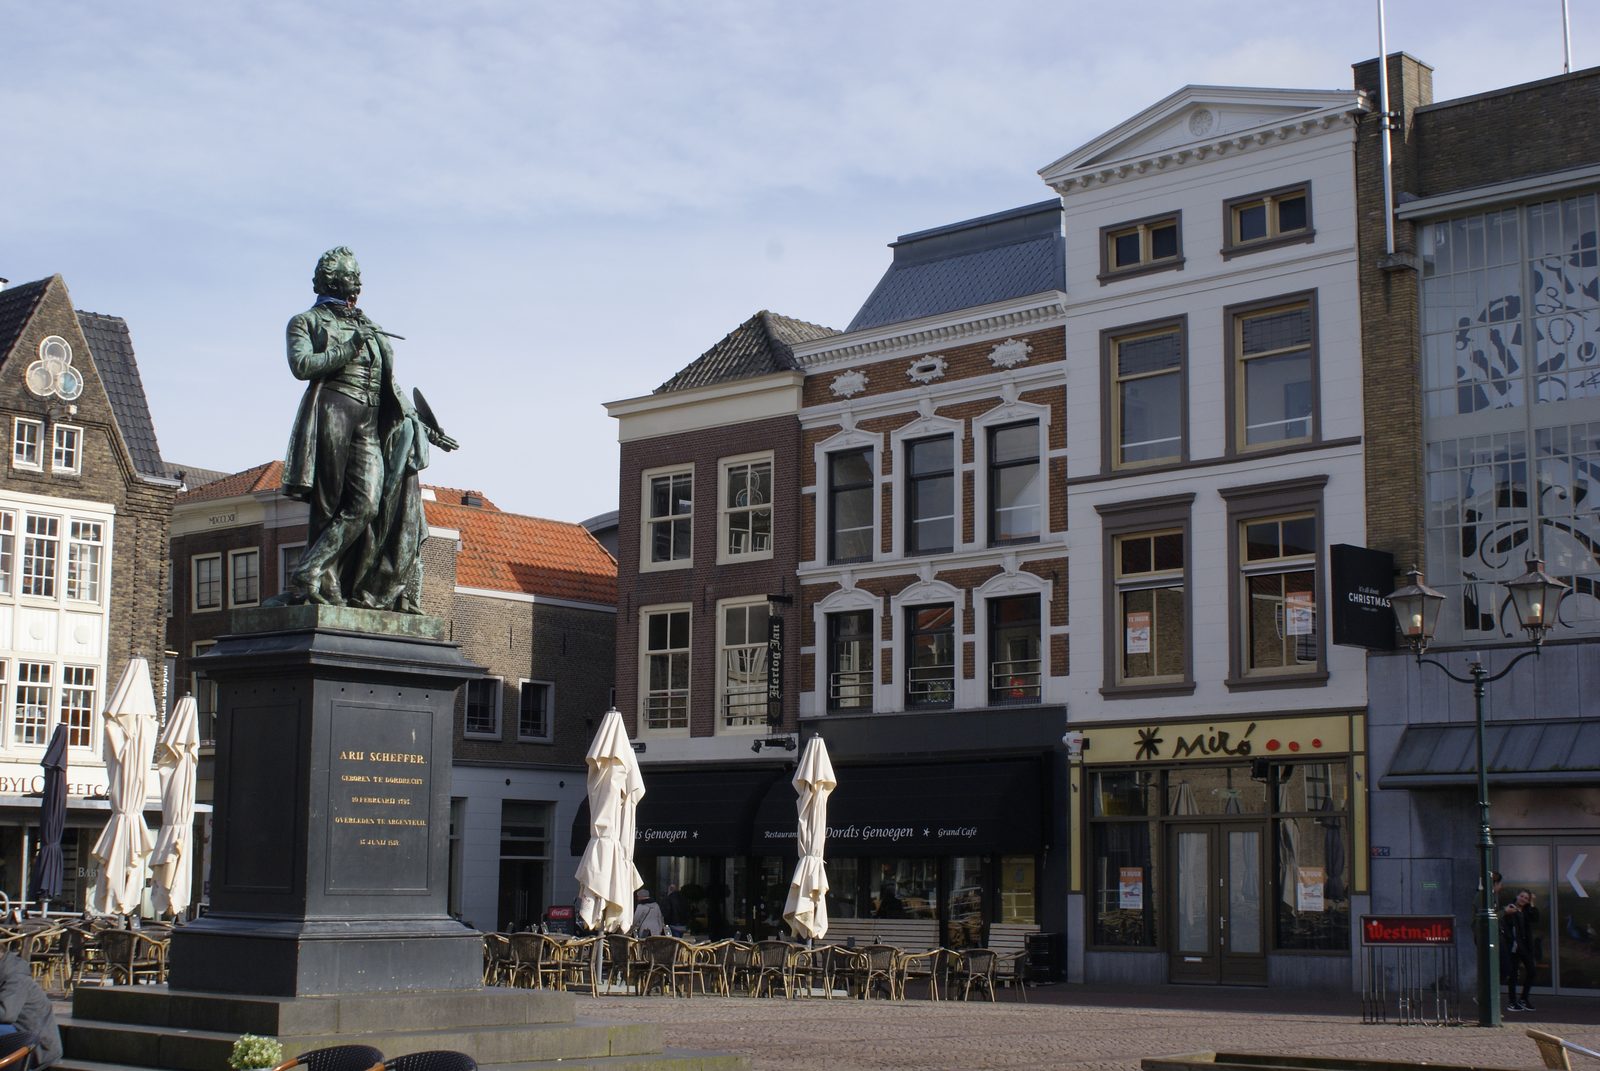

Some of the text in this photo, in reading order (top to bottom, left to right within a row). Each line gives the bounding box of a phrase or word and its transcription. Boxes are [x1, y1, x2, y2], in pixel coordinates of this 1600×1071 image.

[1348, 592, 1391, 608] CHRISTMAS
[769, 624, 782, 699] Hertog Jan
[1172, 722, 1257, 759] Miró
[644, 828, 688, 843] Genoegen
[825, 825, 860, 839] Dordts
[862, 825, 914, 841] Genoegen
[937, 827, 960, 838] Grand
[1366, 920, 1452, 940] Westmalle
